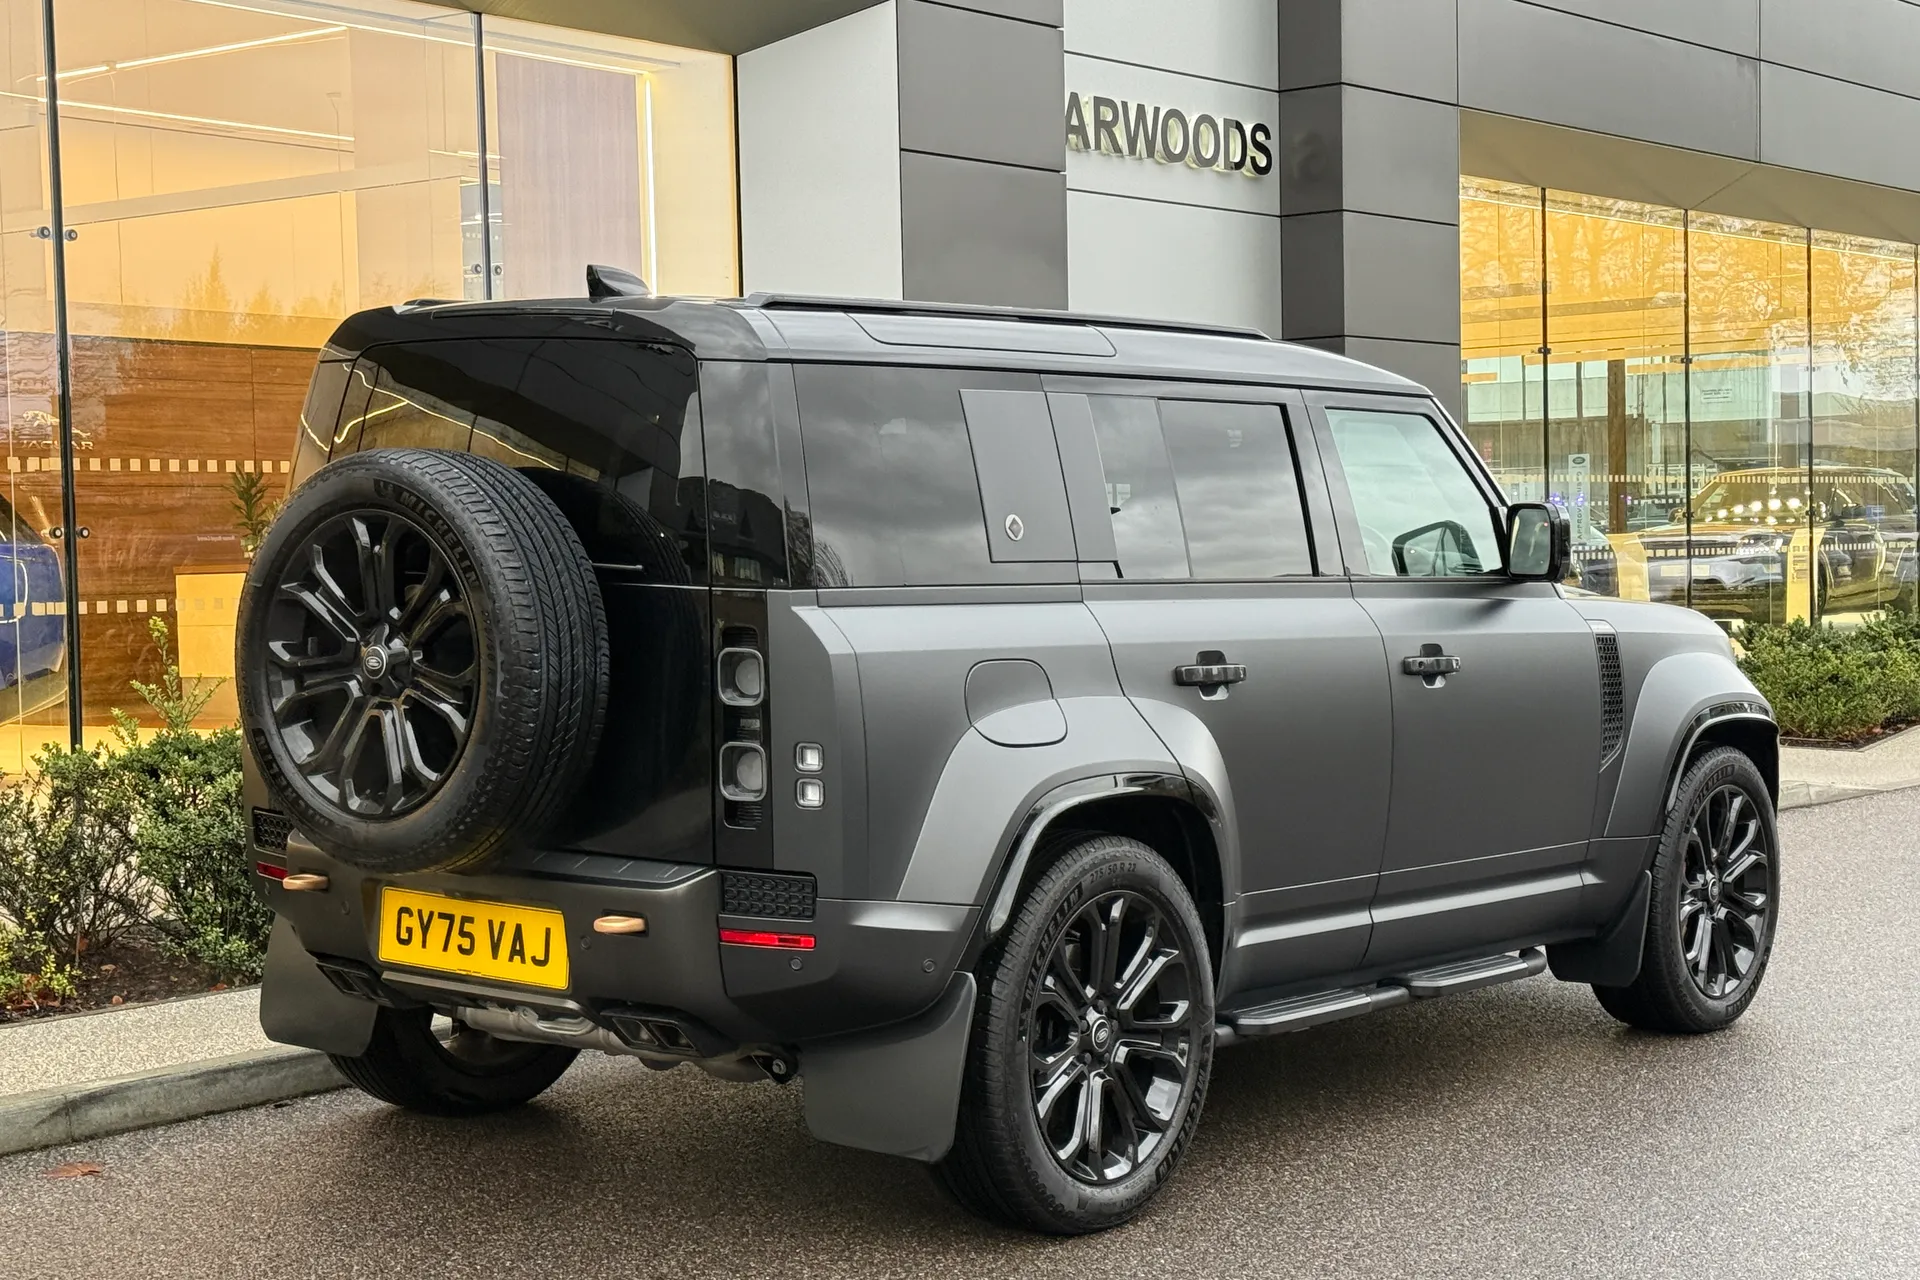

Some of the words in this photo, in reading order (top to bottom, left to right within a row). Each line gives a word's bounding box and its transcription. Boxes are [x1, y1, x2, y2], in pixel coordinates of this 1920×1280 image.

[1065, 91, 1273, 176] ARWOODS
[400, 491, 480, 587] MICHELIN
[396, 906, 476, 957] GY75
[487, 918, 552, 968] VAJ
[1025, 888, 1080, 1001] MICHELIN
